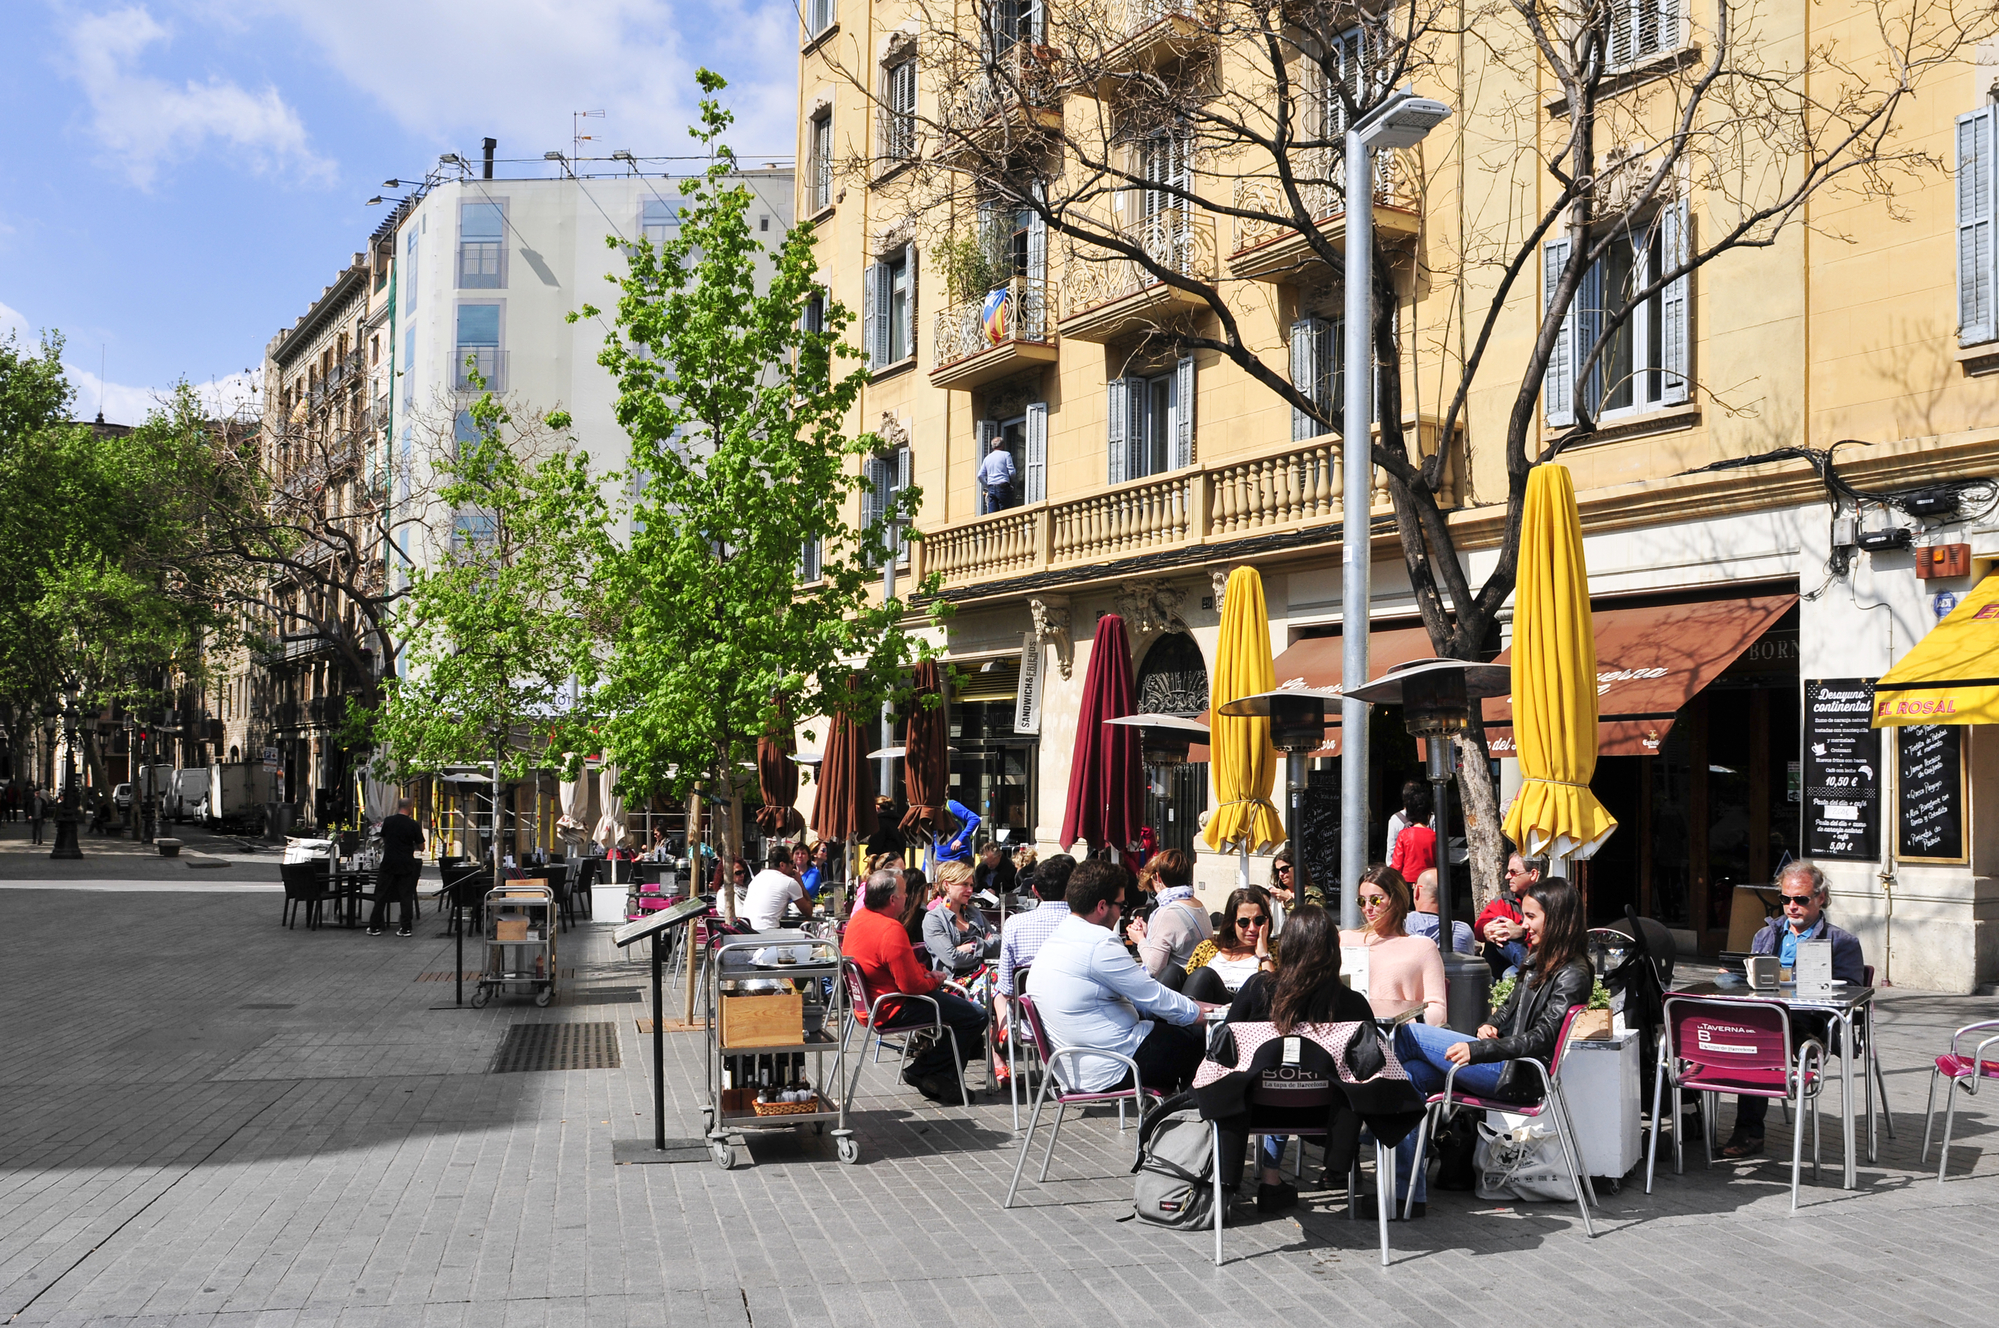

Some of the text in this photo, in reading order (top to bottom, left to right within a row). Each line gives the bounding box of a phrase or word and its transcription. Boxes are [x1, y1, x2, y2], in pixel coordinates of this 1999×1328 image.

[1818, 688, 1866, 702] Desayuno
[1813, 700, 1871, 712] continental
[1878, 700, 1956, 716] EL ROSAL
[1492, 737, 1513, 751] del
[1826, 776, 1858, 787] 10,50 €
[1829, 842, 1853, 851] 5,00 €
[1702, 1023, 1745, 1033] TAVERNA
[1698, 1030, 1711, 1041] B
